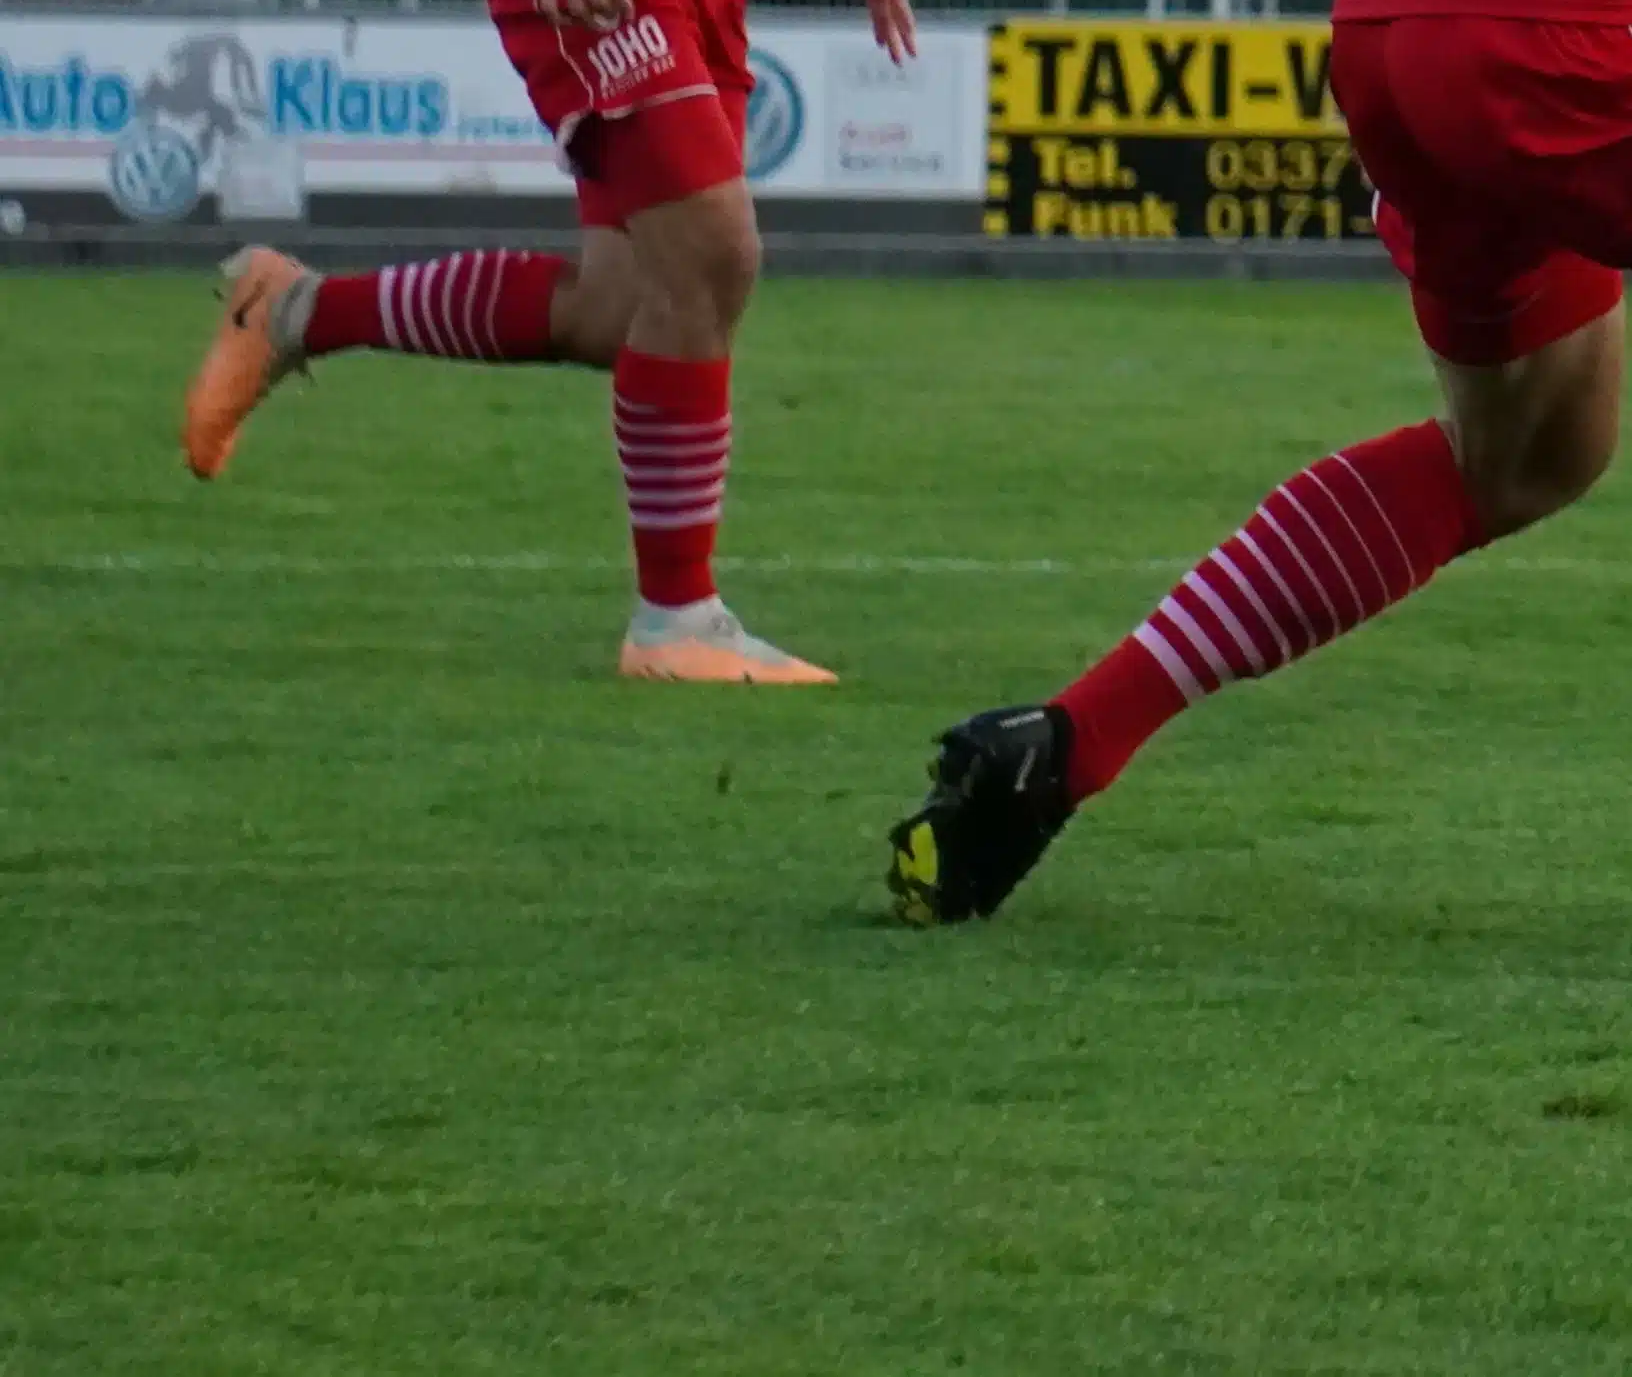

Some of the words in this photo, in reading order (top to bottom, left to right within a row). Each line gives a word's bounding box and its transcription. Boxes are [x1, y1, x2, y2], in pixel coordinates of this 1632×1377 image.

[586, 13, 669, 101] JOHO
[267, 57, 449, 137] Klaus
[1031, 137, 1137, 190] Tel.
[1031, 191, 1178, 239] Funk
